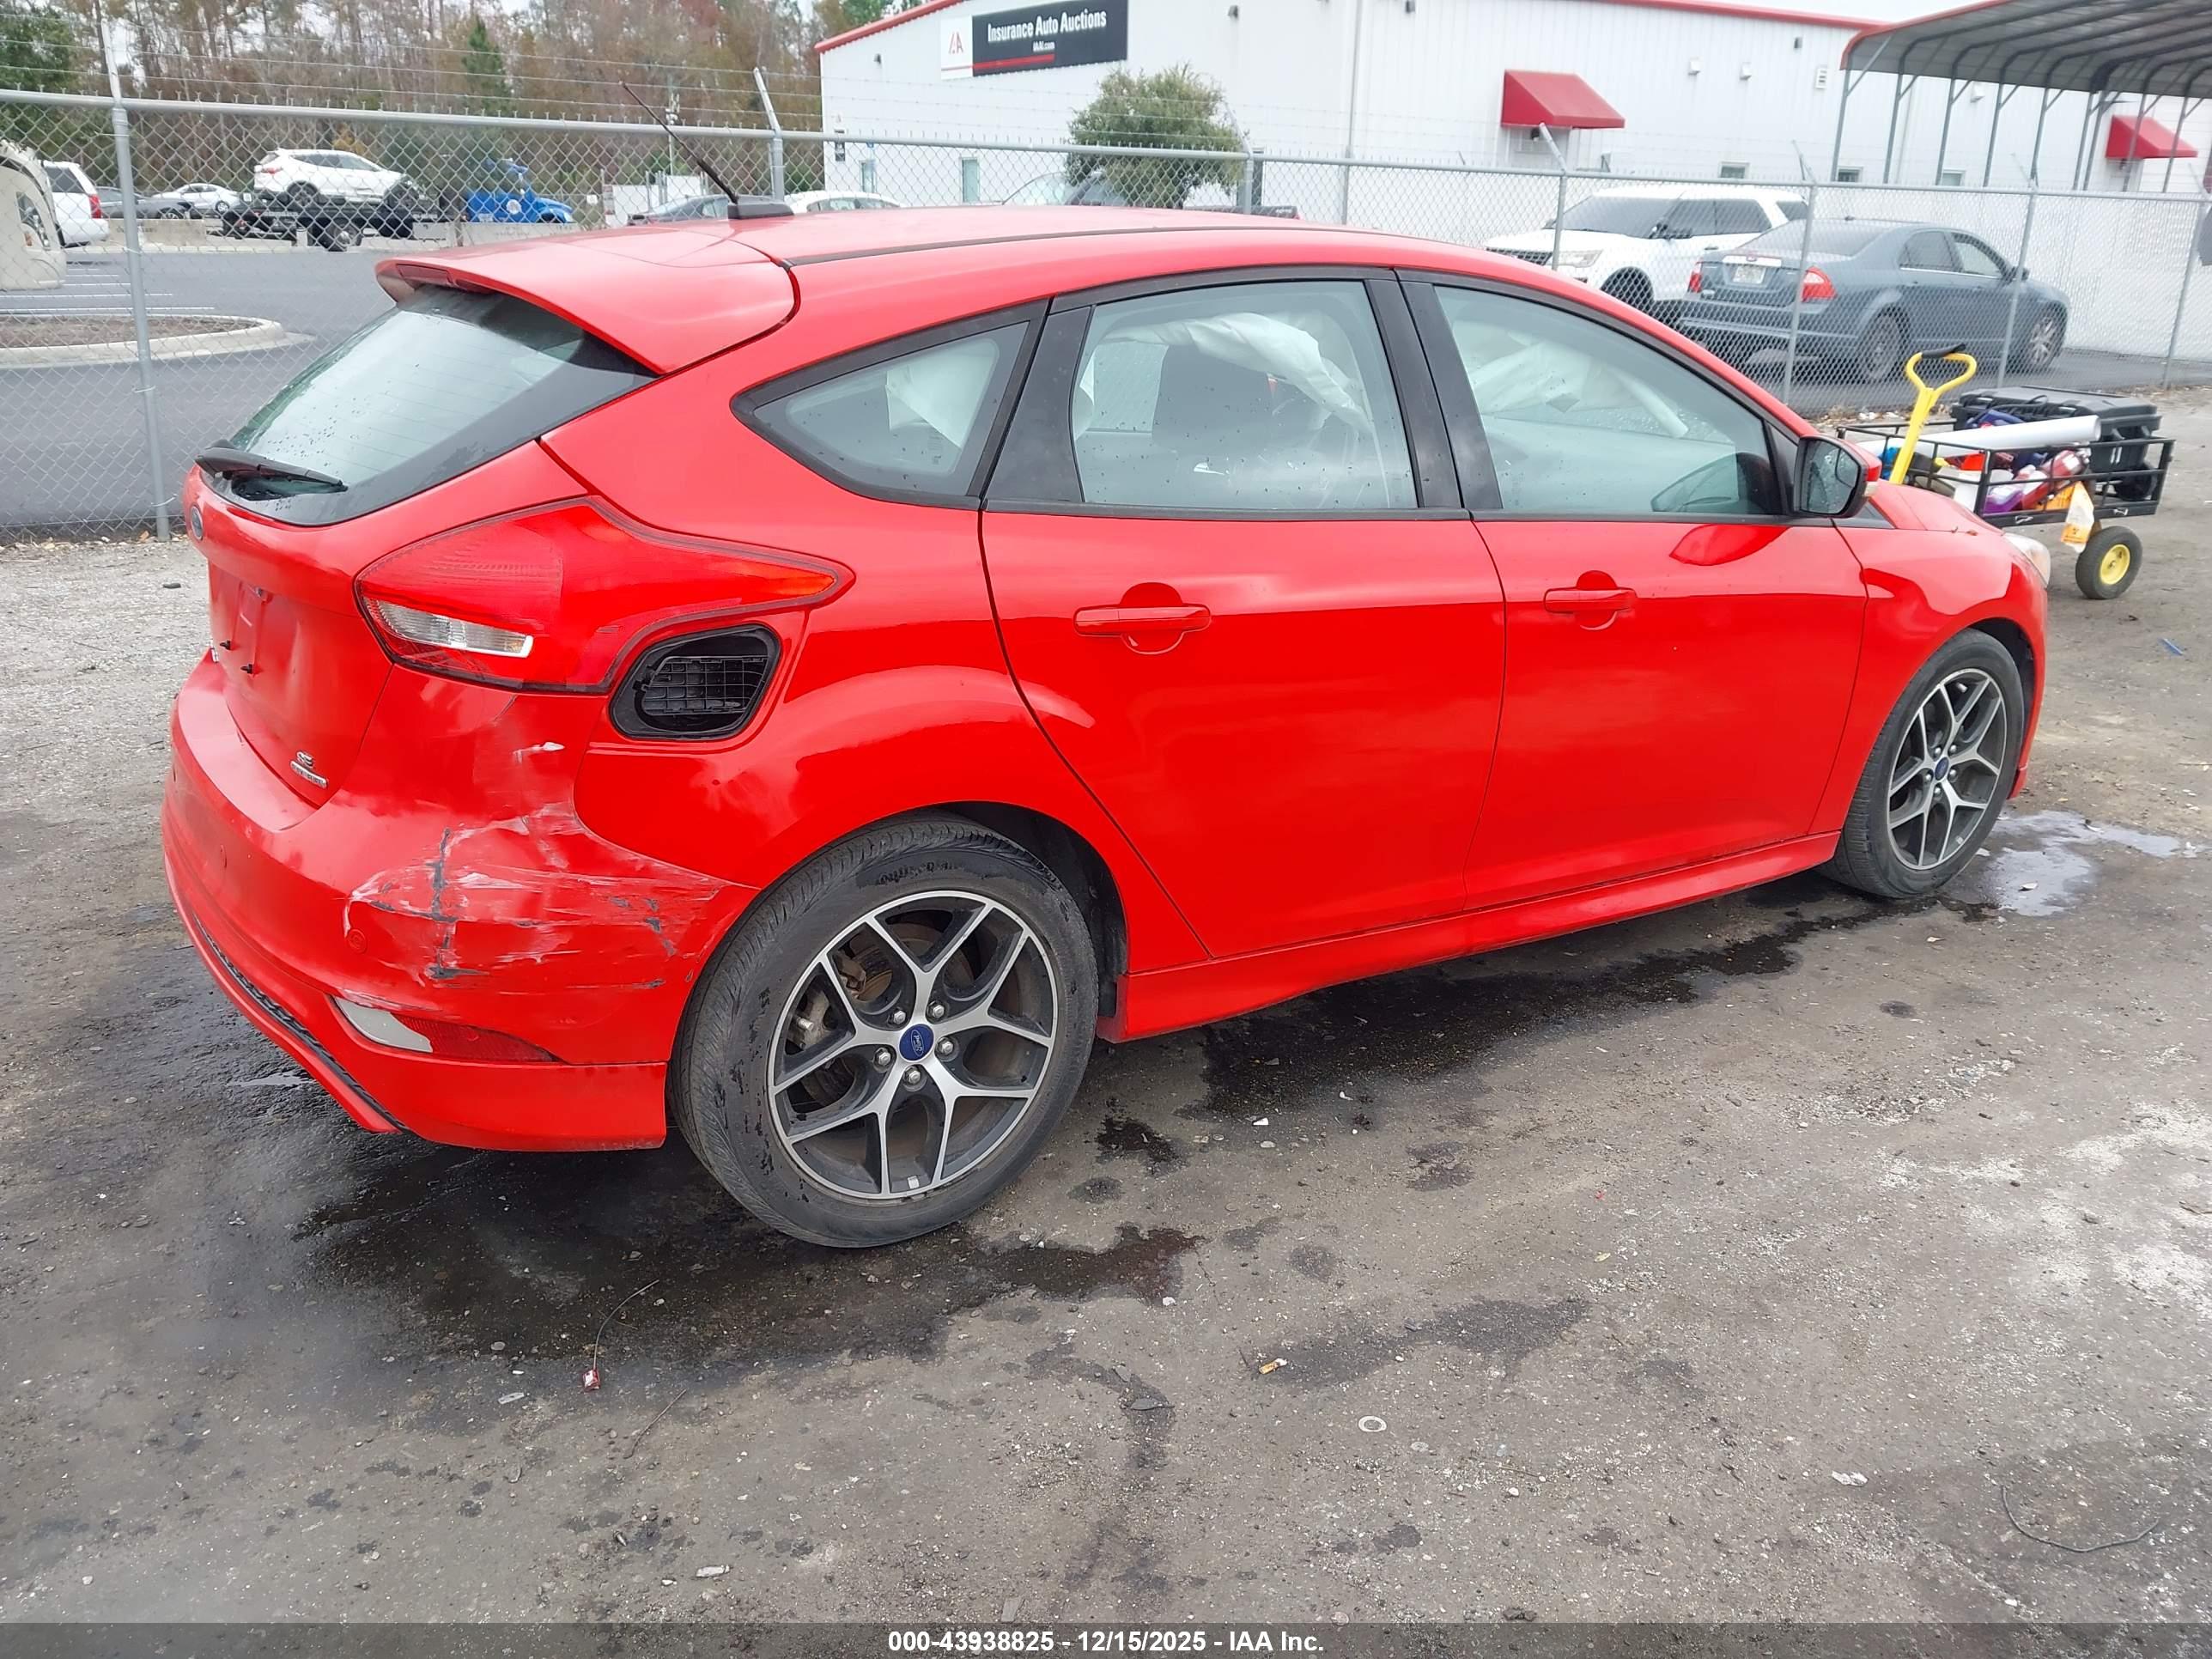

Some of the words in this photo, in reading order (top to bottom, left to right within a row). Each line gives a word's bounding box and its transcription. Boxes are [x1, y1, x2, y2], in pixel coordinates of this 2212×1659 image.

[988, 22, 1034, 42] Insurance
[1035, 15, 1059, 35] Auto
[1060, 8, 1107, 33] Auctions
